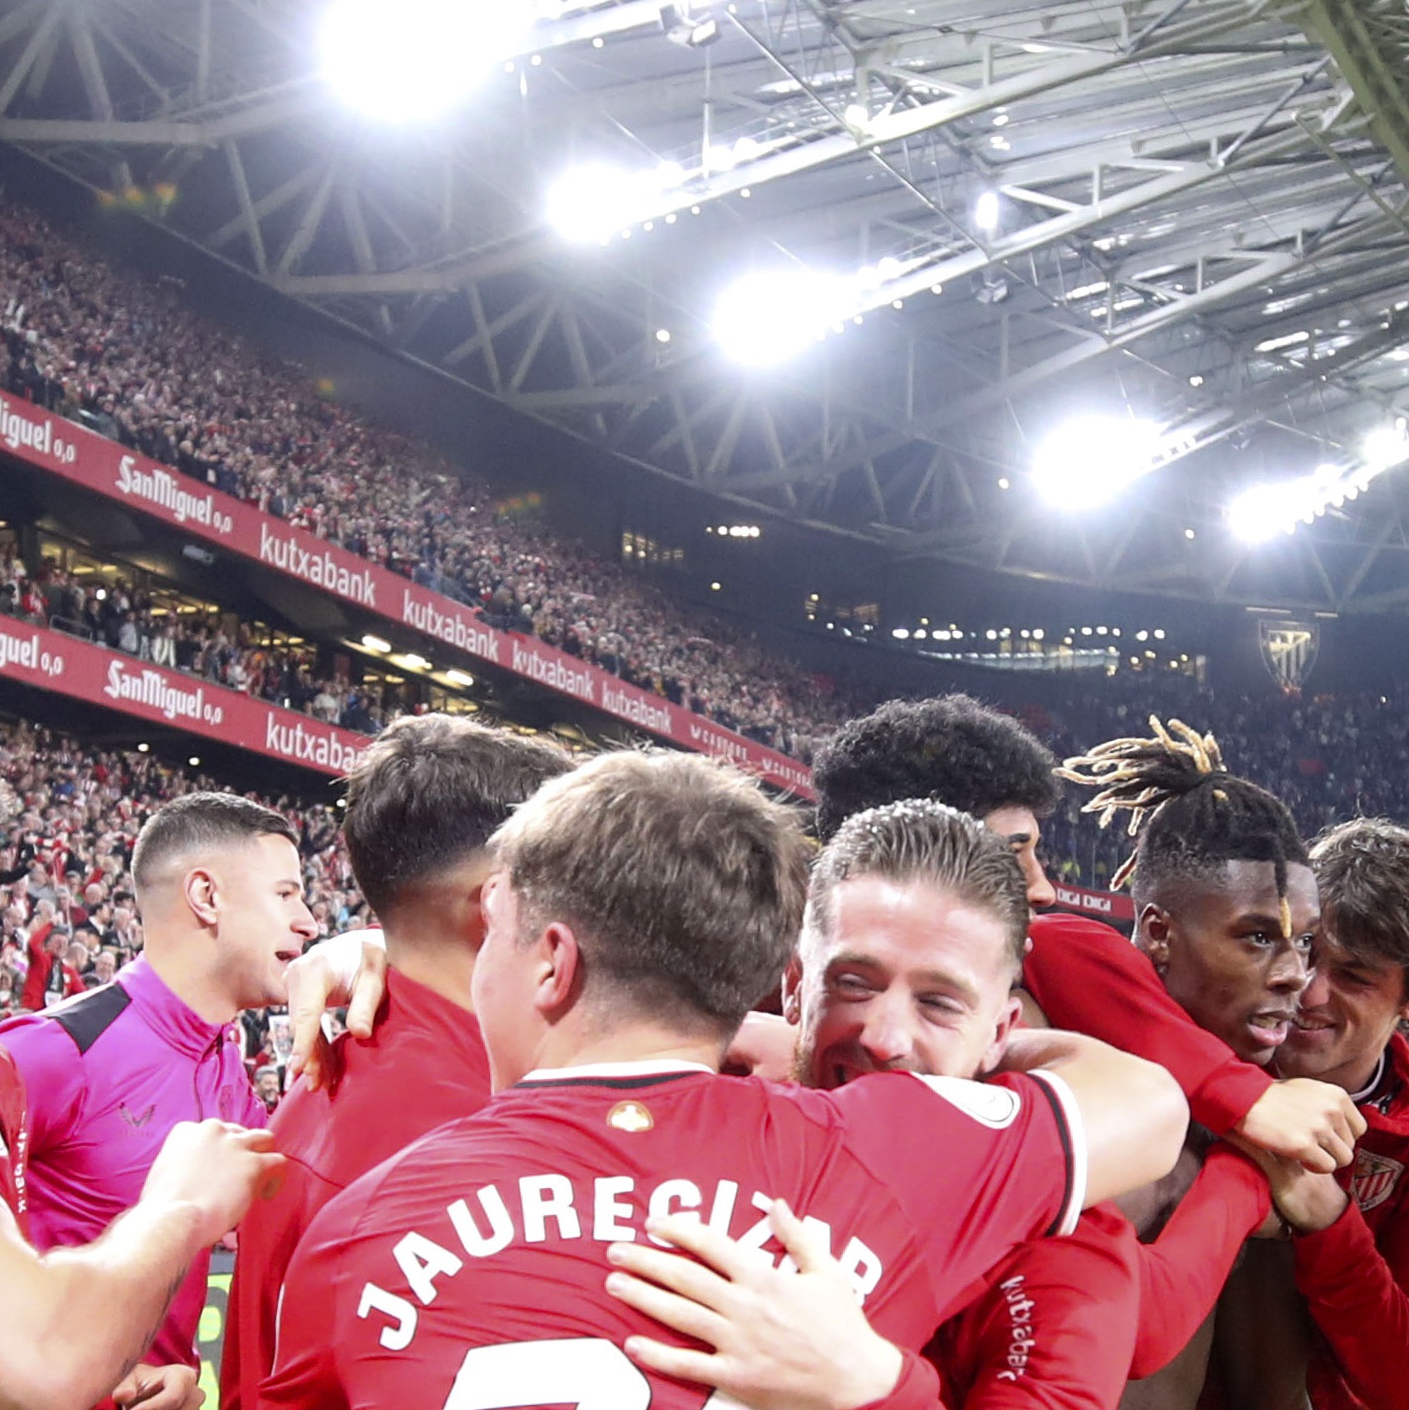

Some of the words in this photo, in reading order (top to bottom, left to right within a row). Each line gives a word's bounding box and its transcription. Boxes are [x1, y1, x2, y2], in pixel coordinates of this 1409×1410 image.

[260, 523, 376, 606] kutxabank
[402, 590, 498, 662] kutxabank
[513, 640, 594, 699] kutxabank
[602, 681, 672, 733] kutxabank
[266, 712, 367, 773] kutxaba
